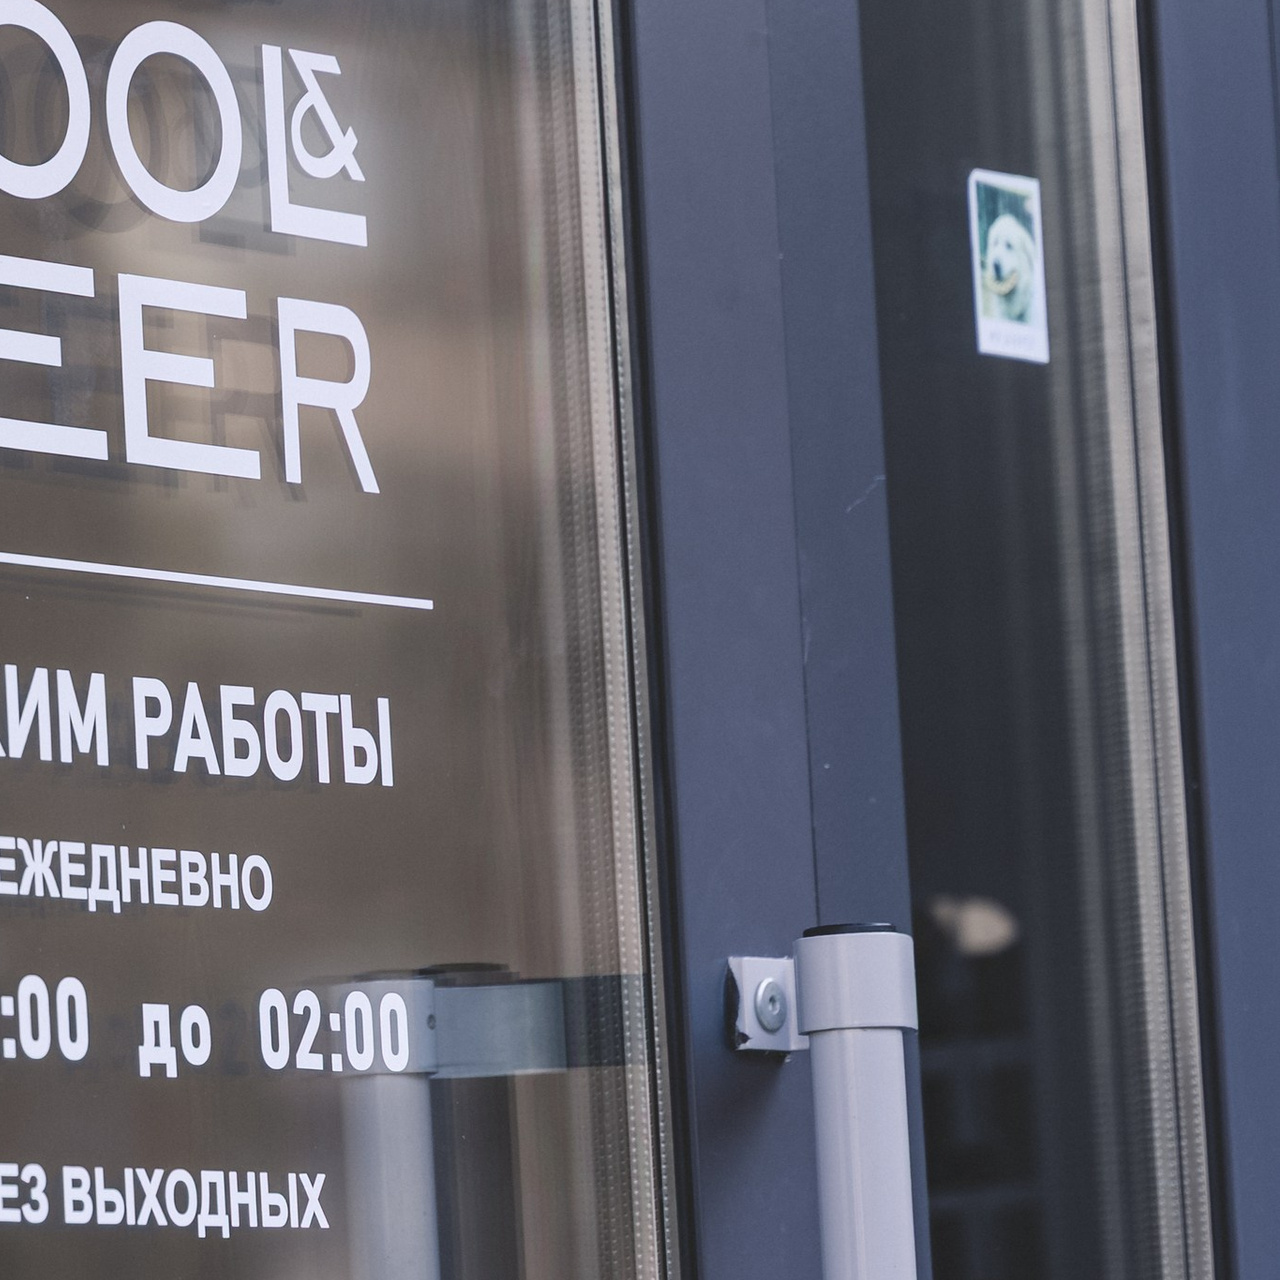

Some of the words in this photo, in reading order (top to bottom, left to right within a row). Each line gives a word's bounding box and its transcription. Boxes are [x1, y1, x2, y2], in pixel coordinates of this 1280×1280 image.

[133, 677, 394, 787] РАБОТЫ
[138, 1003, 212, 1078] до
[259, 988, 409, 1073] 02:00
[63, 1166, 330, 1239] ВЫХОДНЫХ
